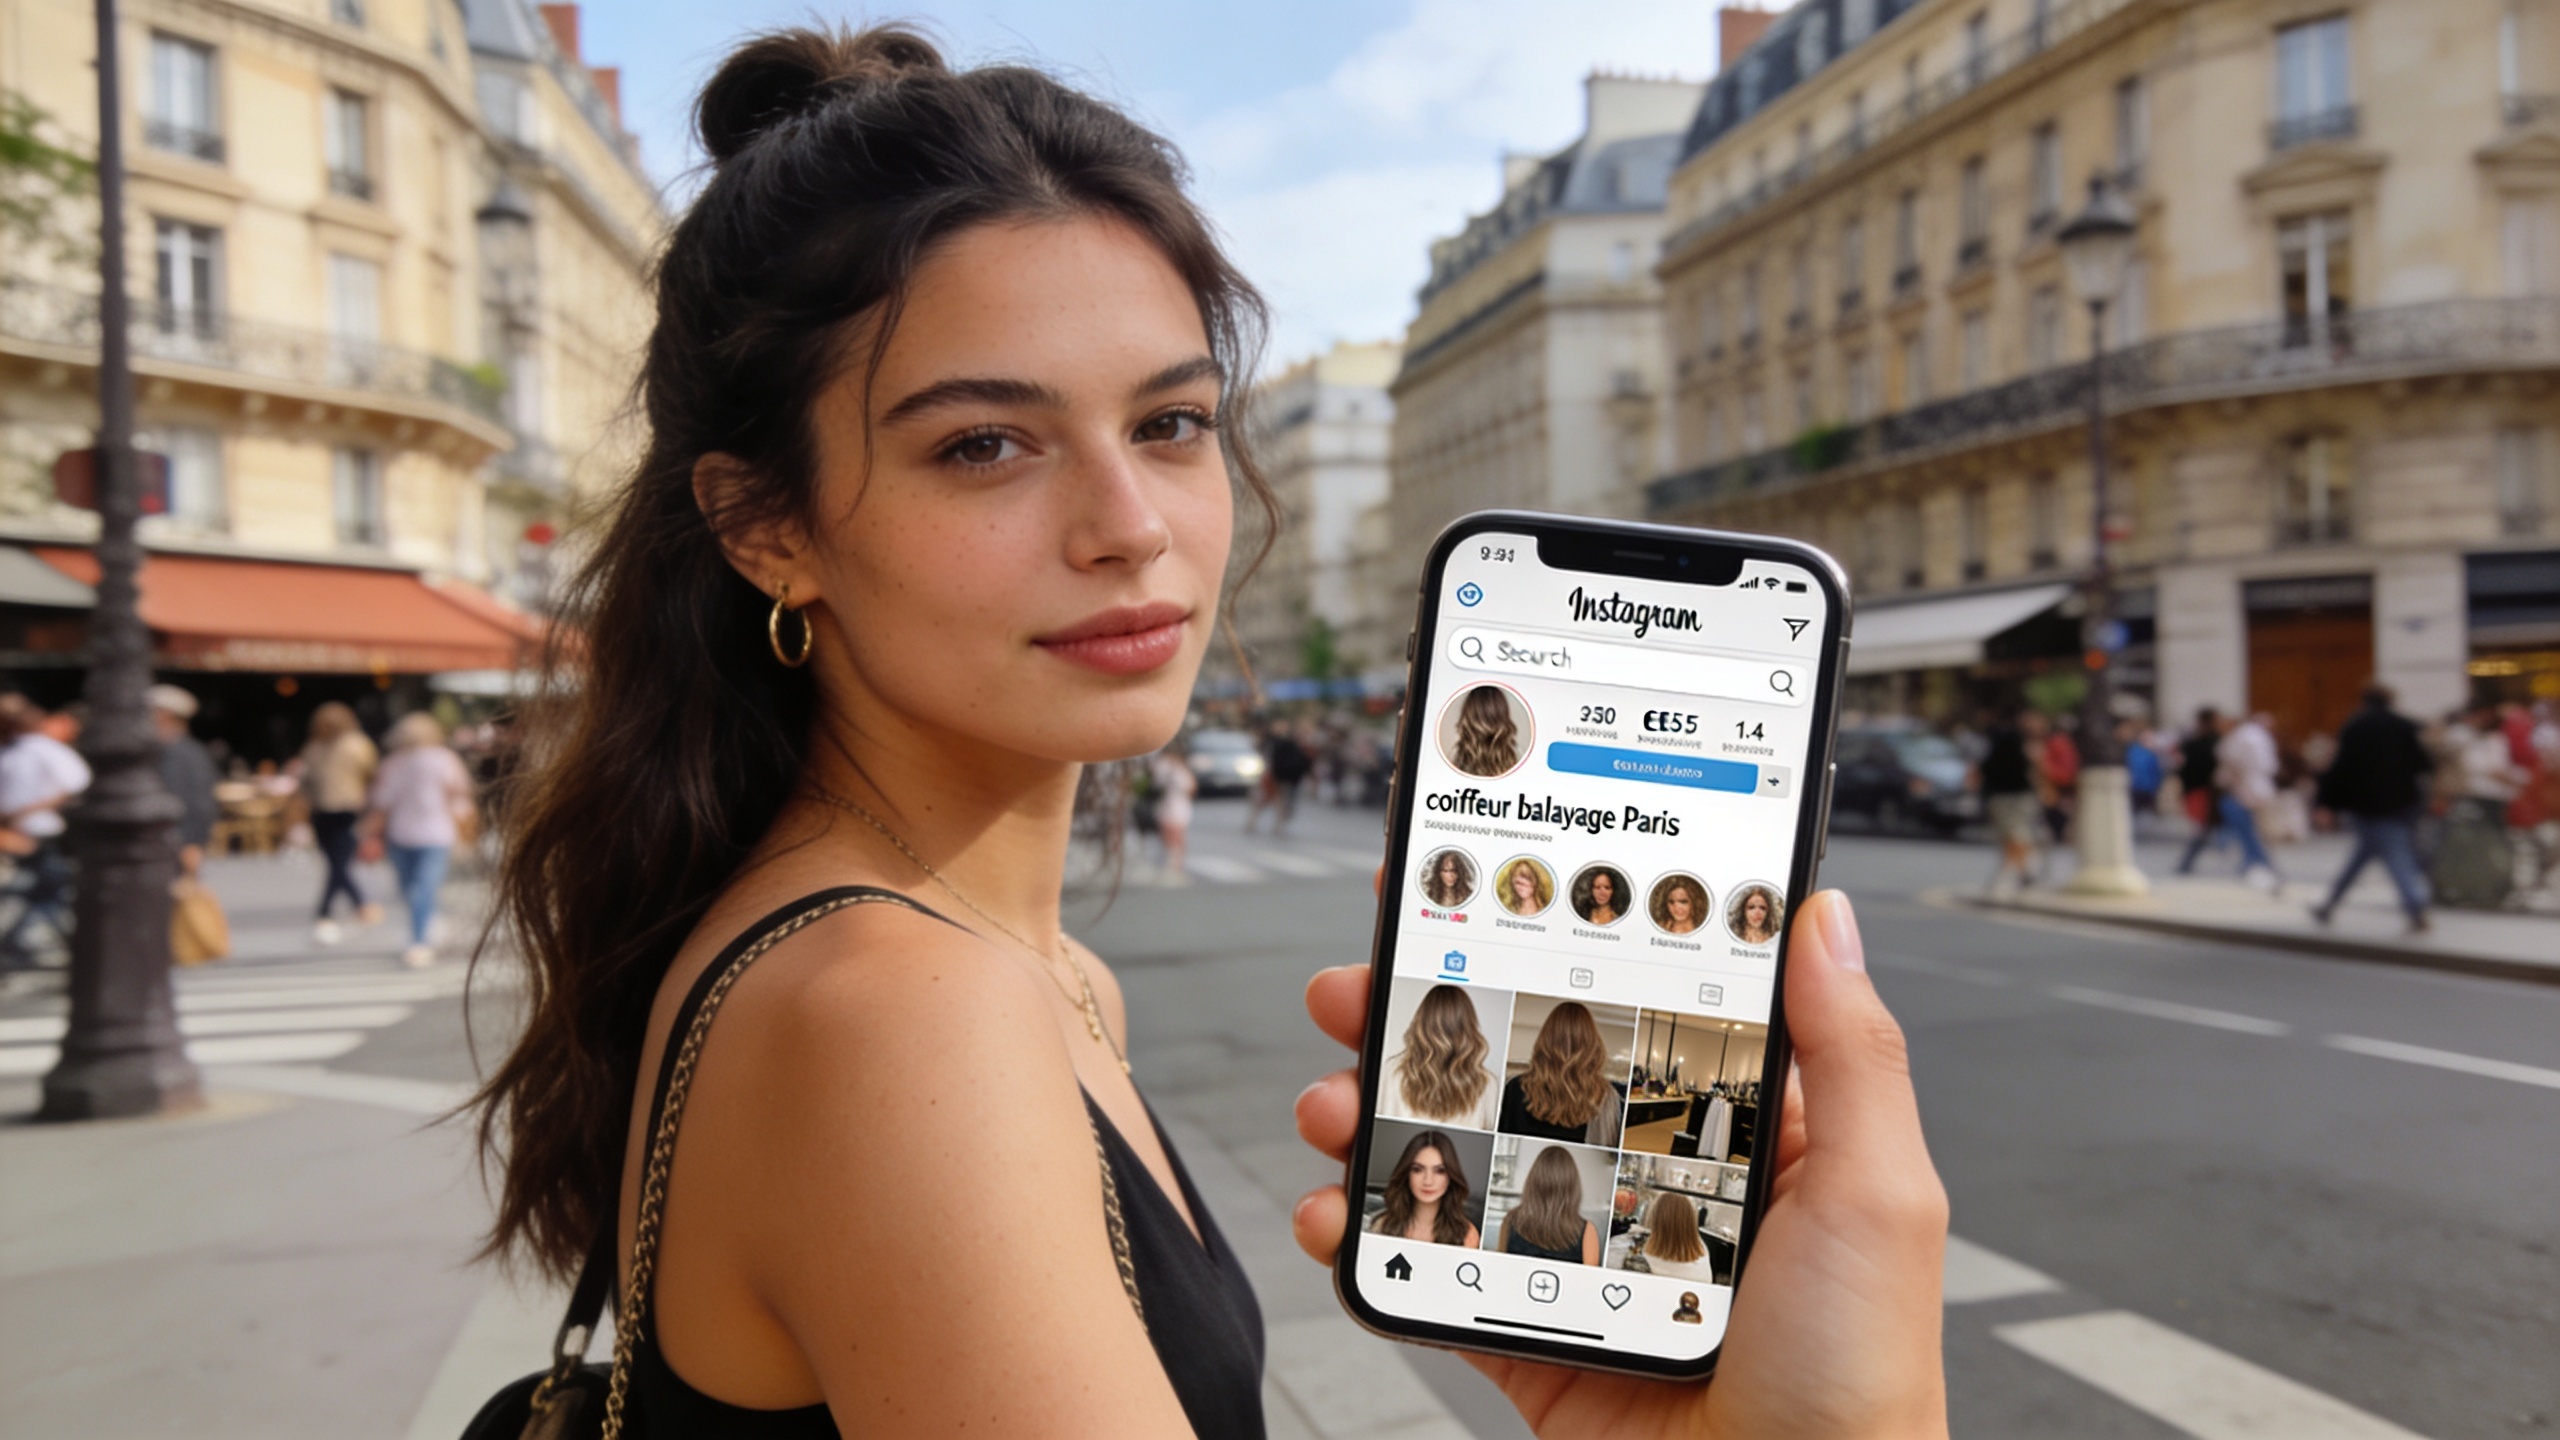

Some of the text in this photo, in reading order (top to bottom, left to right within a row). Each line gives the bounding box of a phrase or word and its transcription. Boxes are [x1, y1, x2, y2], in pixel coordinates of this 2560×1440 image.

[1568, 586, 1703, 639] Instagram
[1735, 720, 1765, 741] 1.4
[1425, 788, 1512, 818] coiffeur
[1517, 793, 1616, 834] balayage
[1622, 806, 1681, 836] Paris
